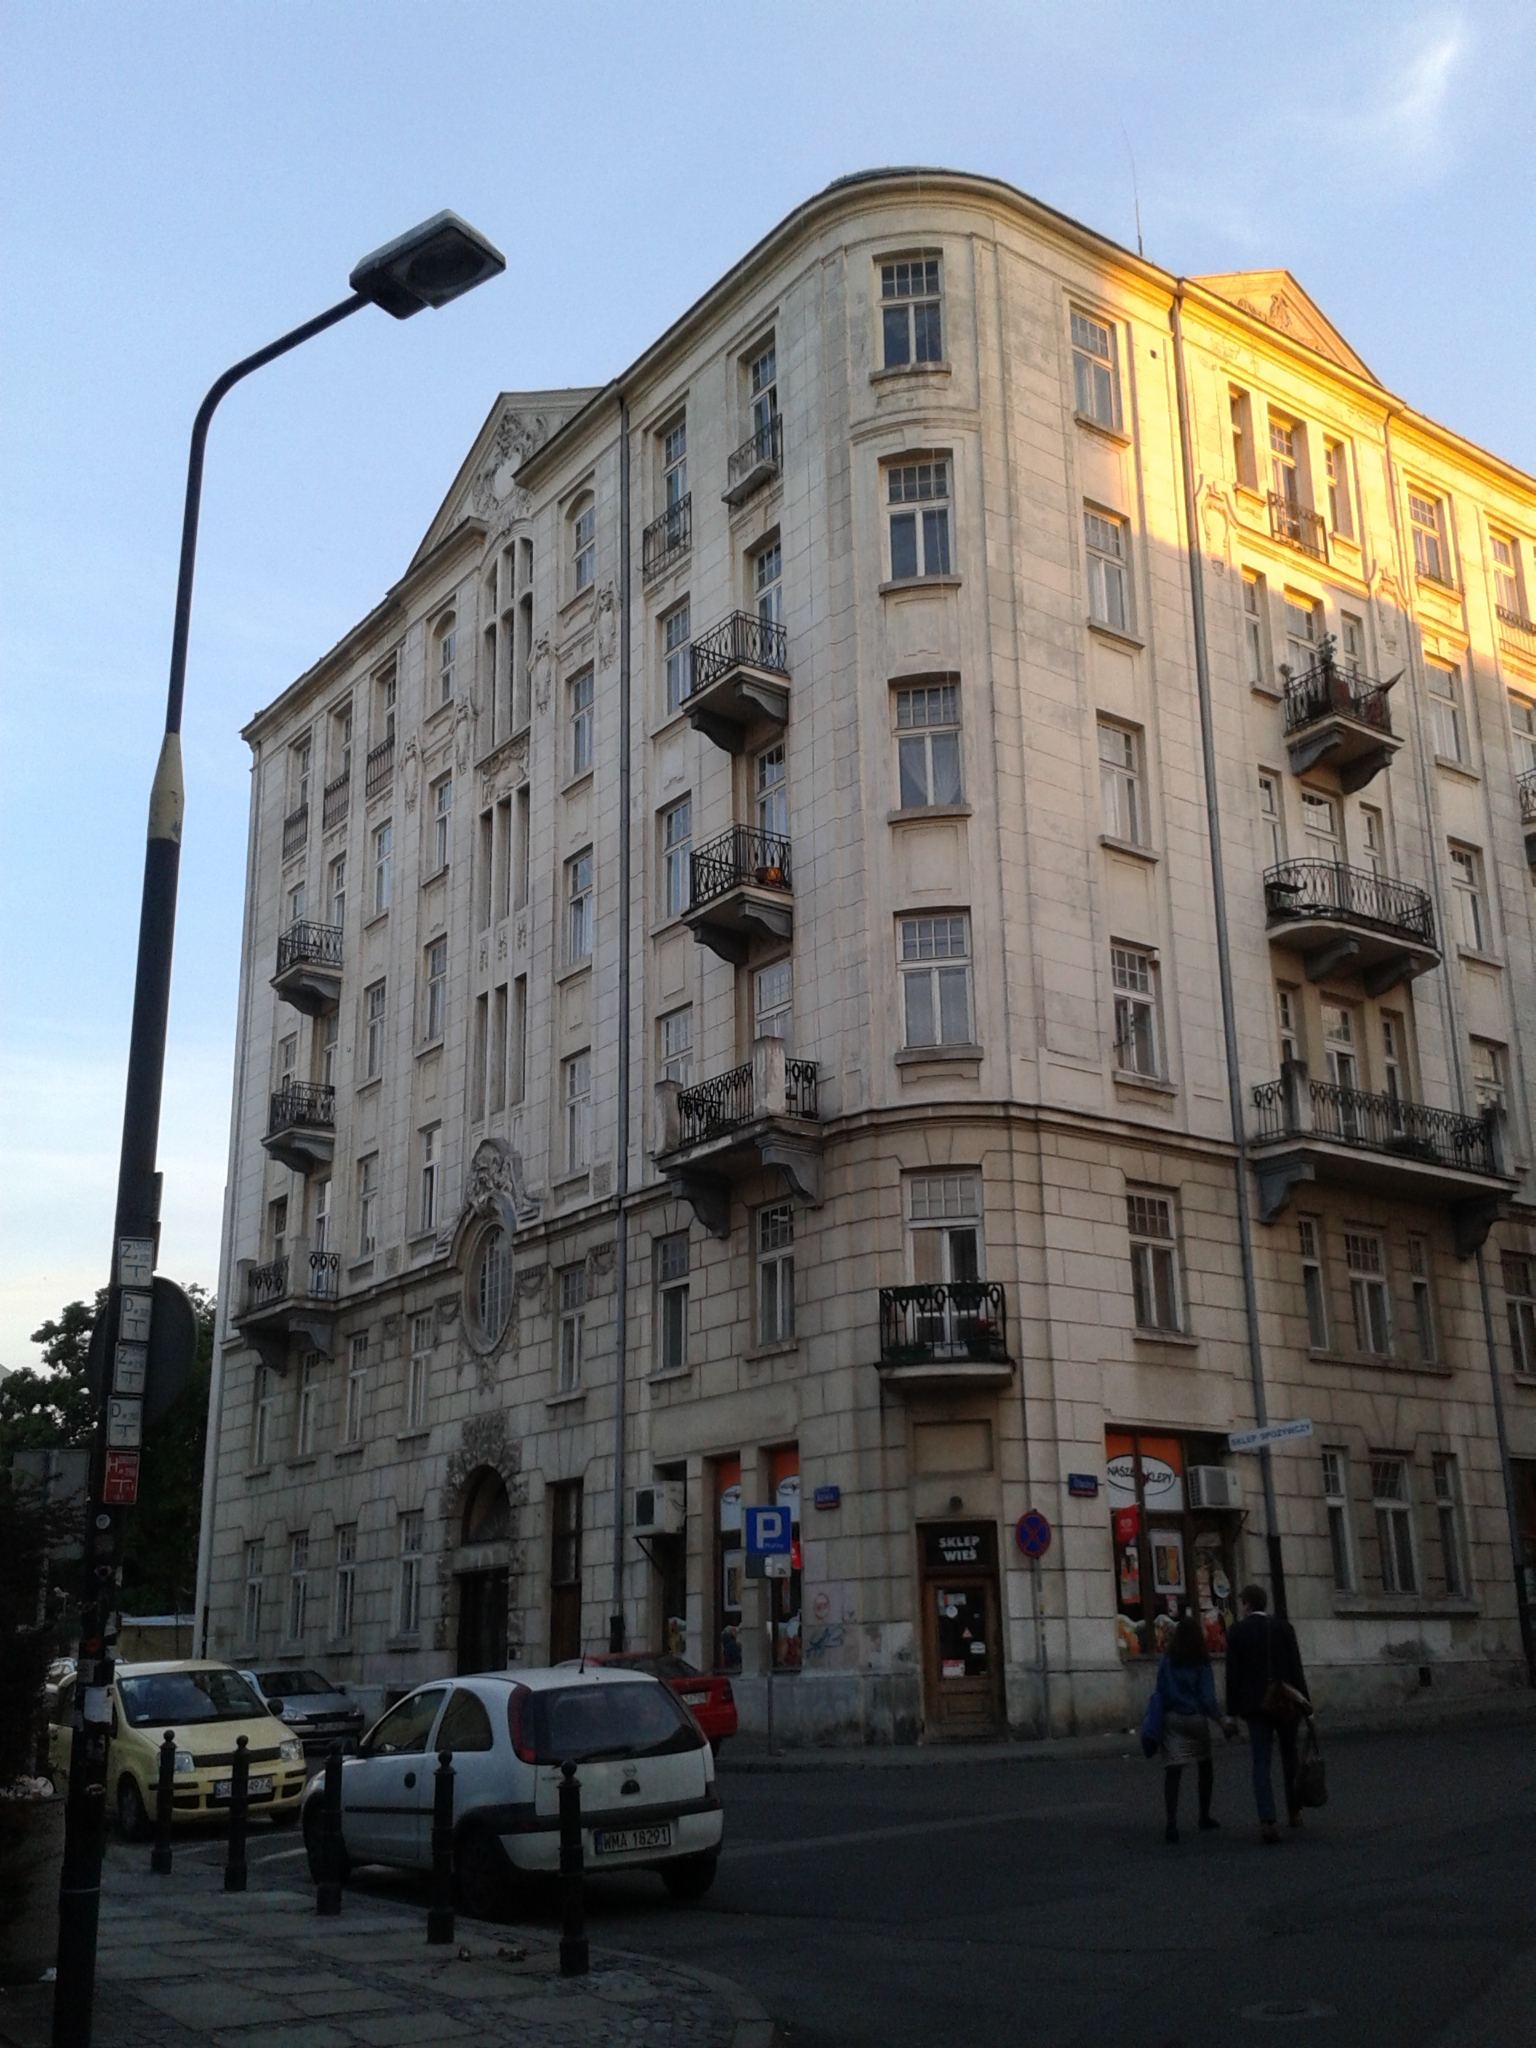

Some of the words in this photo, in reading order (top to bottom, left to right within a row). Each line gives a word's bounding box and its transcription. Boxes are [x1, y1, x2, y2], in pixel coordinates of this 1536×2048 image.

[1231, 1434, 1257, 1446] SKLEP
[756, 1512, 782, 1549] P
[938, 1535, 980, 1549] SKLEP
[943, 1546, 977, 1561] WIEŚ
[604, 1833, 627, 1850] WMA
[633, 1828, 667, 1846] 18291
